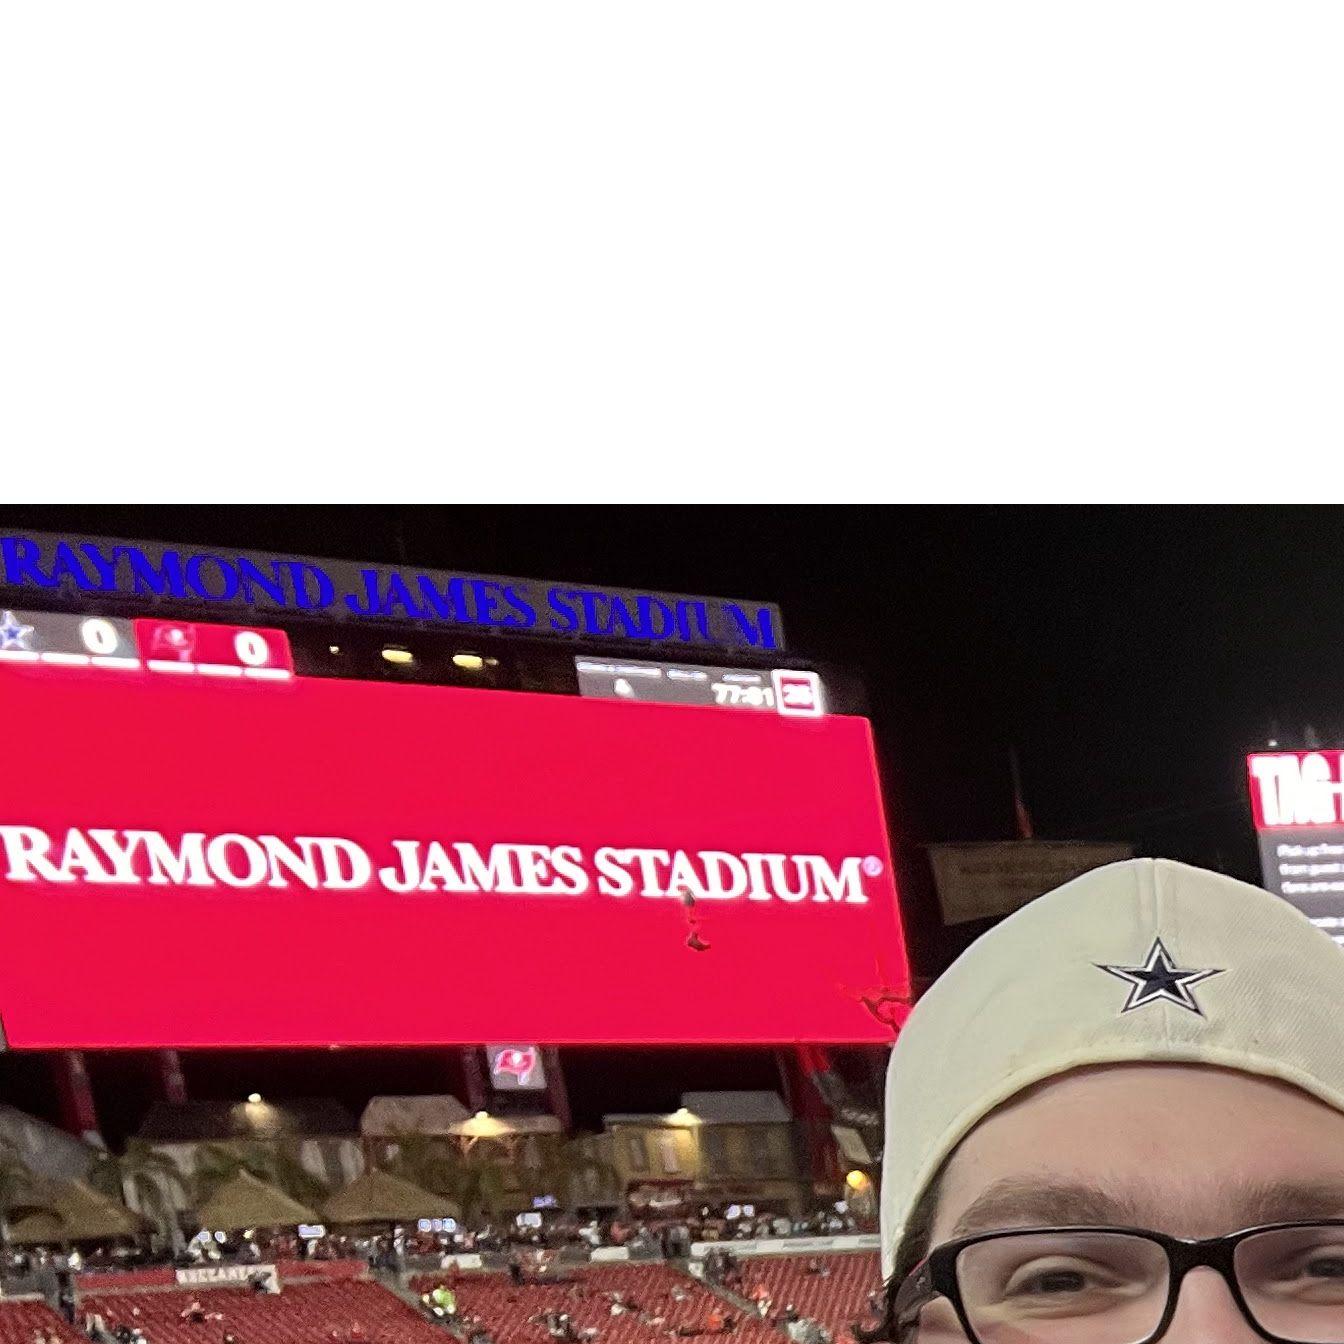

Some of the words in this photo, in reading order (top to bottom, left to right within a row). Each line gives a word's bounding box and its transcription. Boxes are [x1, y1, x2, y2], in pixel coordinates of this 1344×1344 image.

[2, 536, 336, 611] RAYMOND
[345, 568, 536, 629] JAMES
[81, 616, 118, 656] 0
[234, 630, 270, 668] 0
[3, 825, 371, 893] RAYMOND
[379, 840, 583, 895] JAMES
[597, 846, 868, 904] STADIUM
